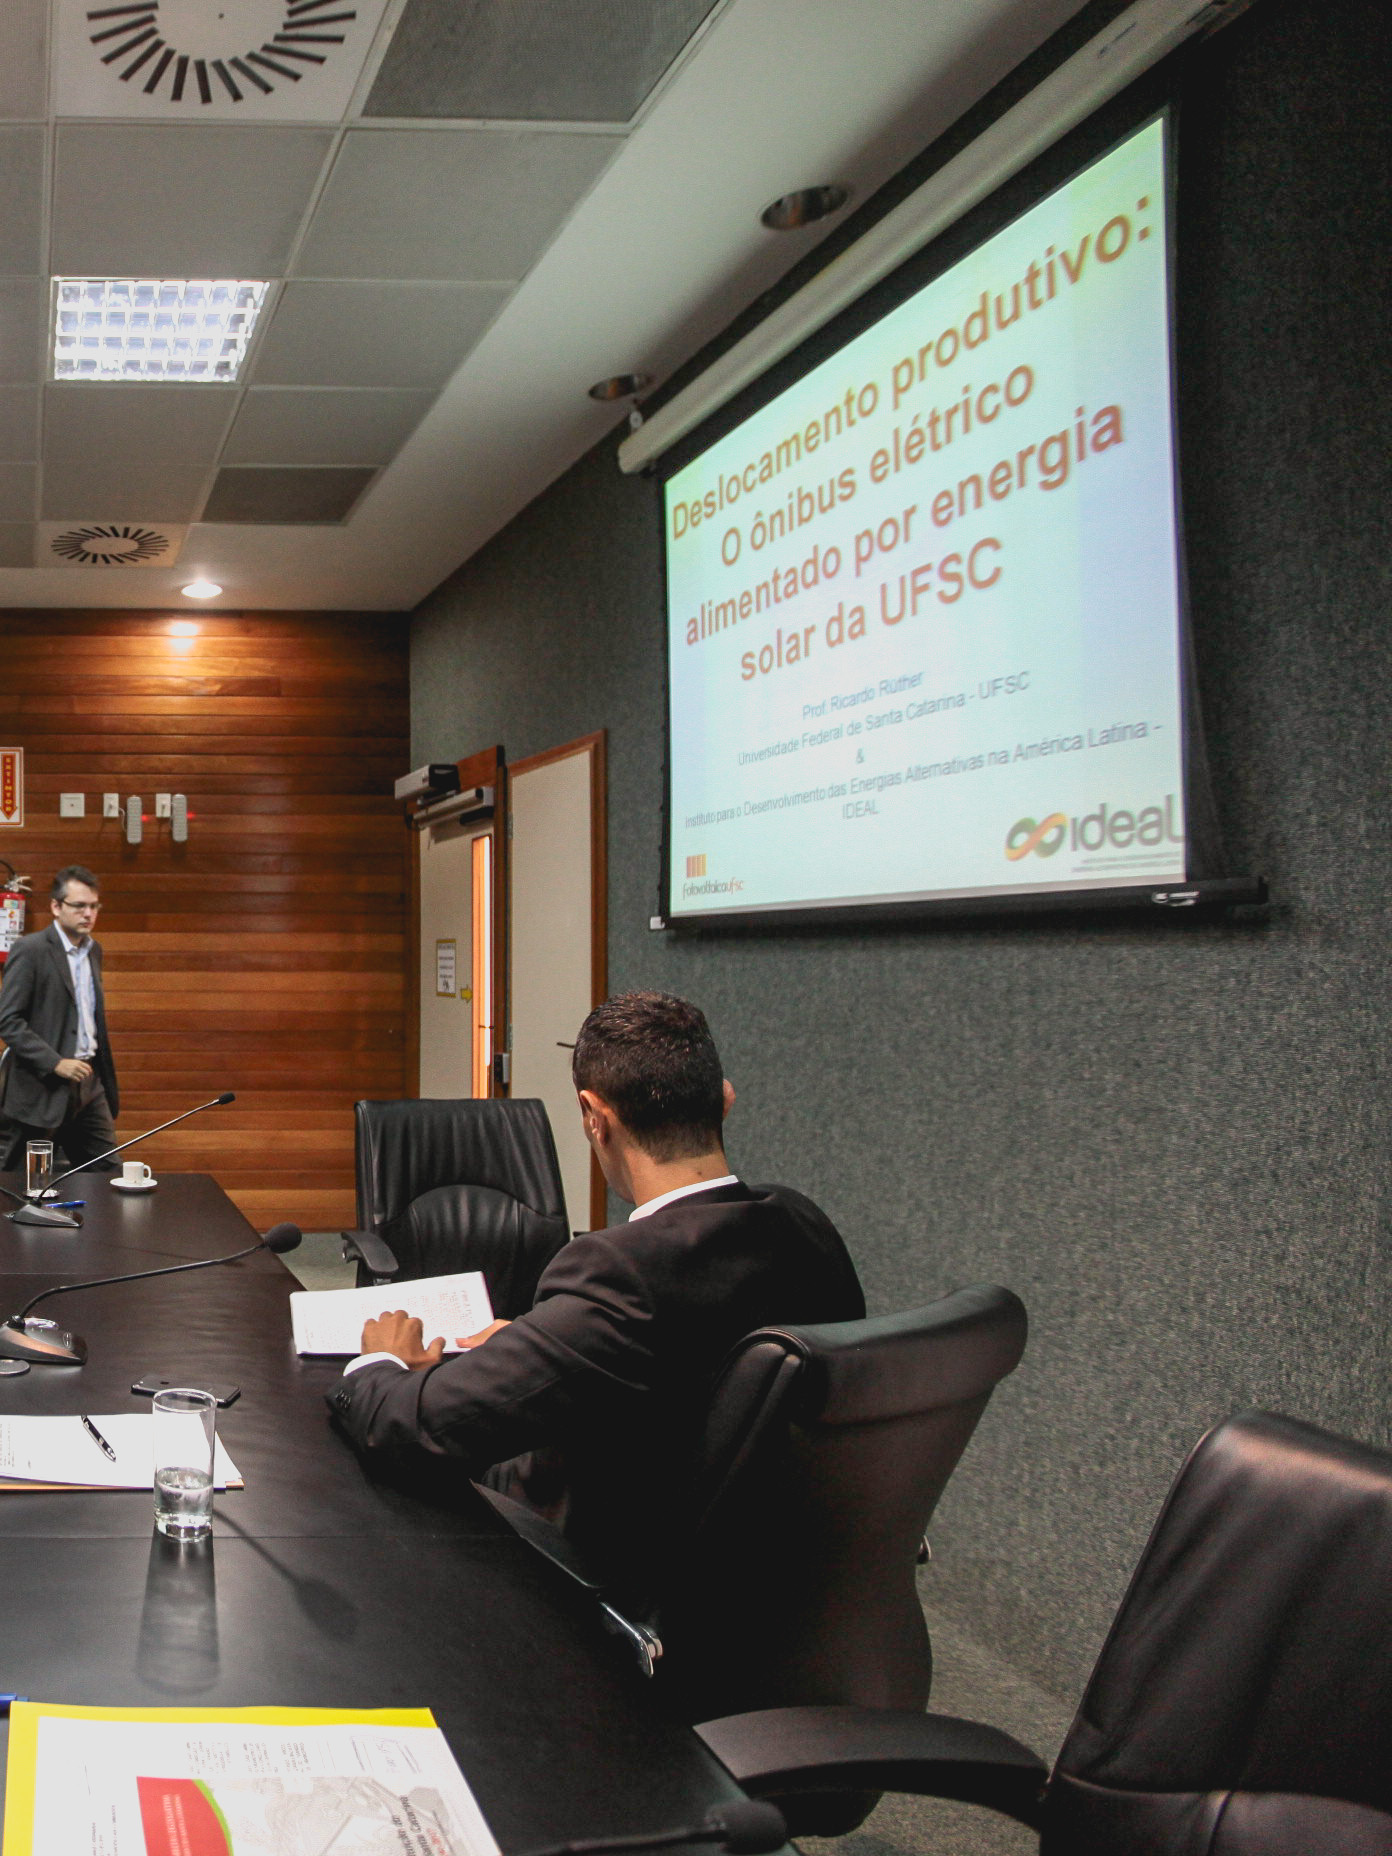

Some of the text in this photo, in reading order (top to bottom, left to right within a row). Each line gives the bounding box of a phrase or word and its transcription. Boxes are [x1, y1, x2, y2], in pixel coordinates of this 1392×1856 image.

[671, 195, 1154, 541] Deslocamento produtivo:
[685, 402, 1125, 647] alimentado por energia
[720, 363, 1035, 567] O ônibus elétrico
[740, 535, 1004, 681] solar da UFSC
[738, 737, 799, 766] Universidade
[801, 723, 844, 749] Federal
[846, 718, 863, 737] de
[865, 708, 903, 731] Santa
[907, 692, 966, 720] Catarina
[978, 670, 1031, 700] UFSC
[830, 687, 876, 711] Ricardo
[716, 807, 735, 824] para
[743, 785, 825, 817] Desenvolvimento
[827, 780, 847, 799] das
[850, 769, 902, 795] Energias
[904, 752, 984, 783] Alternativas
[987, 748, 1010, 766] na
[1087, 720, 1149, 748] Latina
[842, 799, 880, 821] IDEAL
